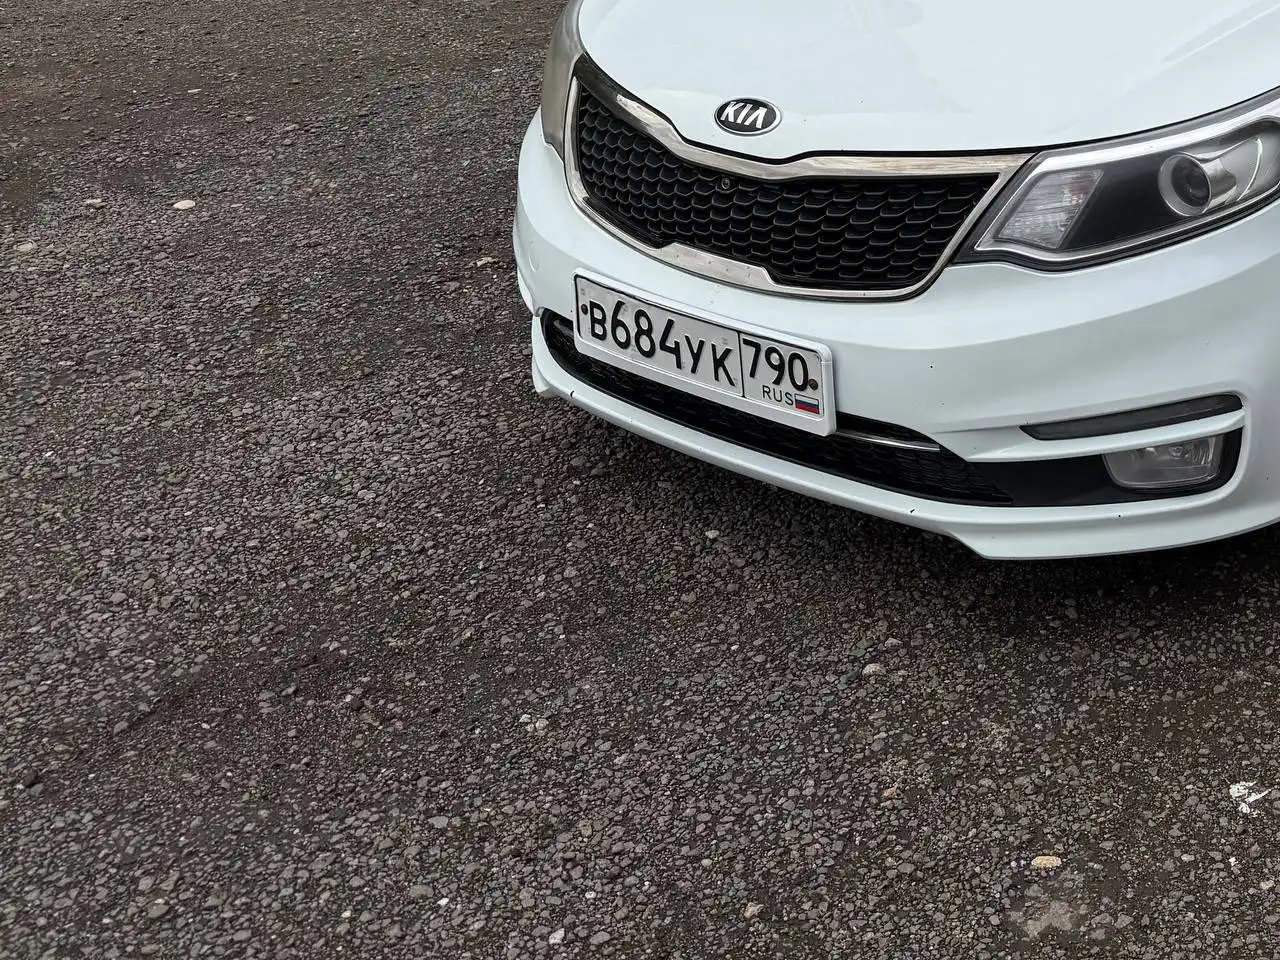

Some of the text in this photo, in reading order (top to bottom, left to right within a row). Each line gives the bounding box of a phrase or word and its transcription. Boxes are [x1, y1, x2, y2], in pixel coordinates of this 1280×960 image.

[720, 101, 768, 129] KIA
[742, 338, 809, 392] 790
[762, 385, 794, 406] RUS
